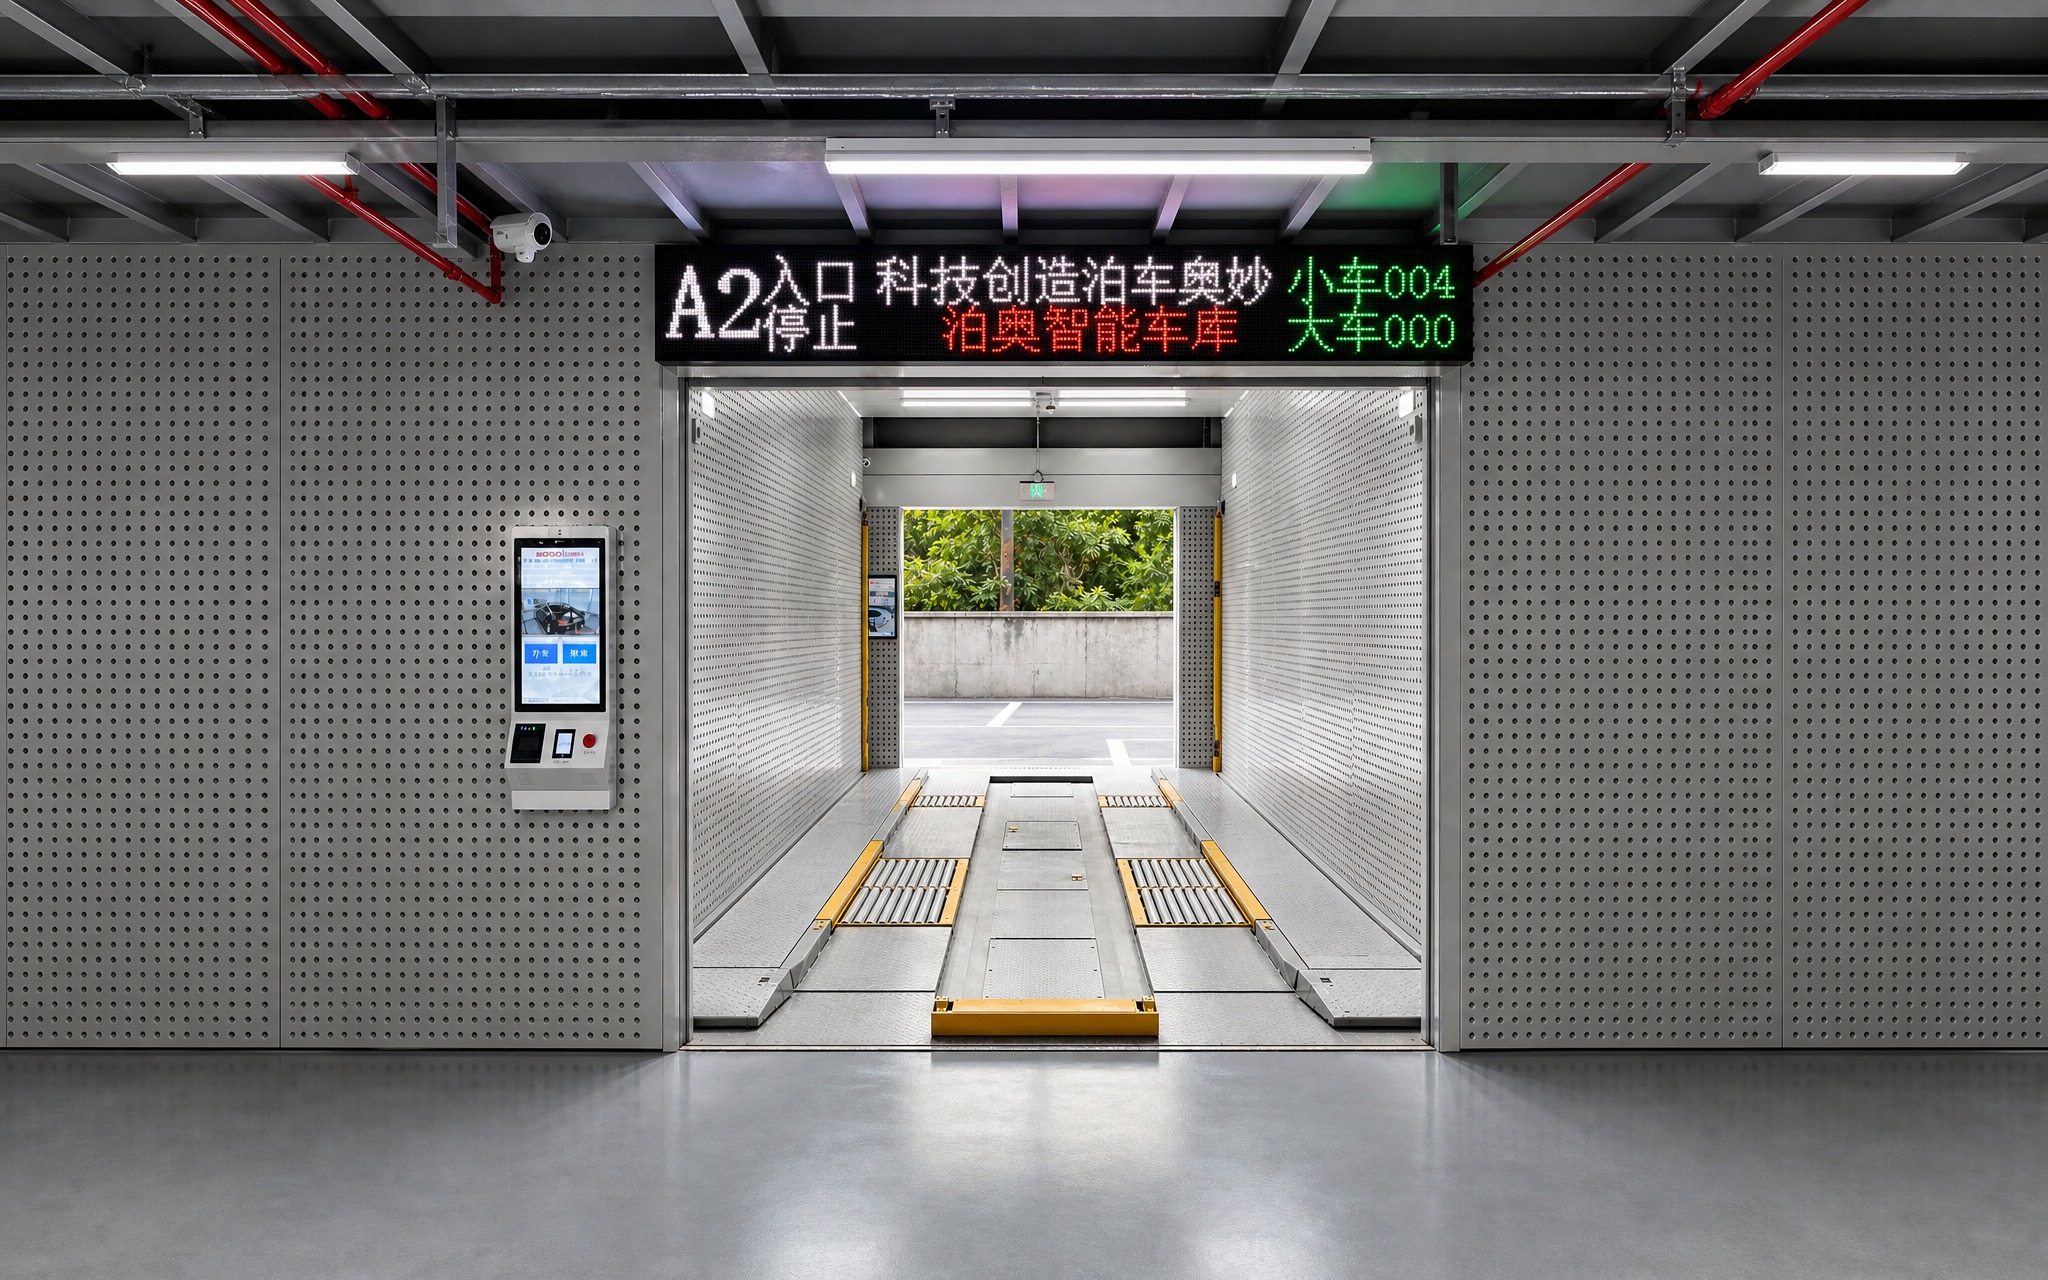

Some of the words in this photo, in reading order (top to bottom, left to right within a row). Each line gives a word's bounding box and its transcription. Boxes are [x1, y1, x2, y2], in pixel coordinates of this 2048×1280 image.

[666, 265, 761, 339] A2
[762, 254, 855, 305] 入口
[876, 255, 1273, 306] 科技创造泊车奥妙
[762, 304, 858, 353] 停止
[942, 304, 1239, 353] 泊奥智能车库
